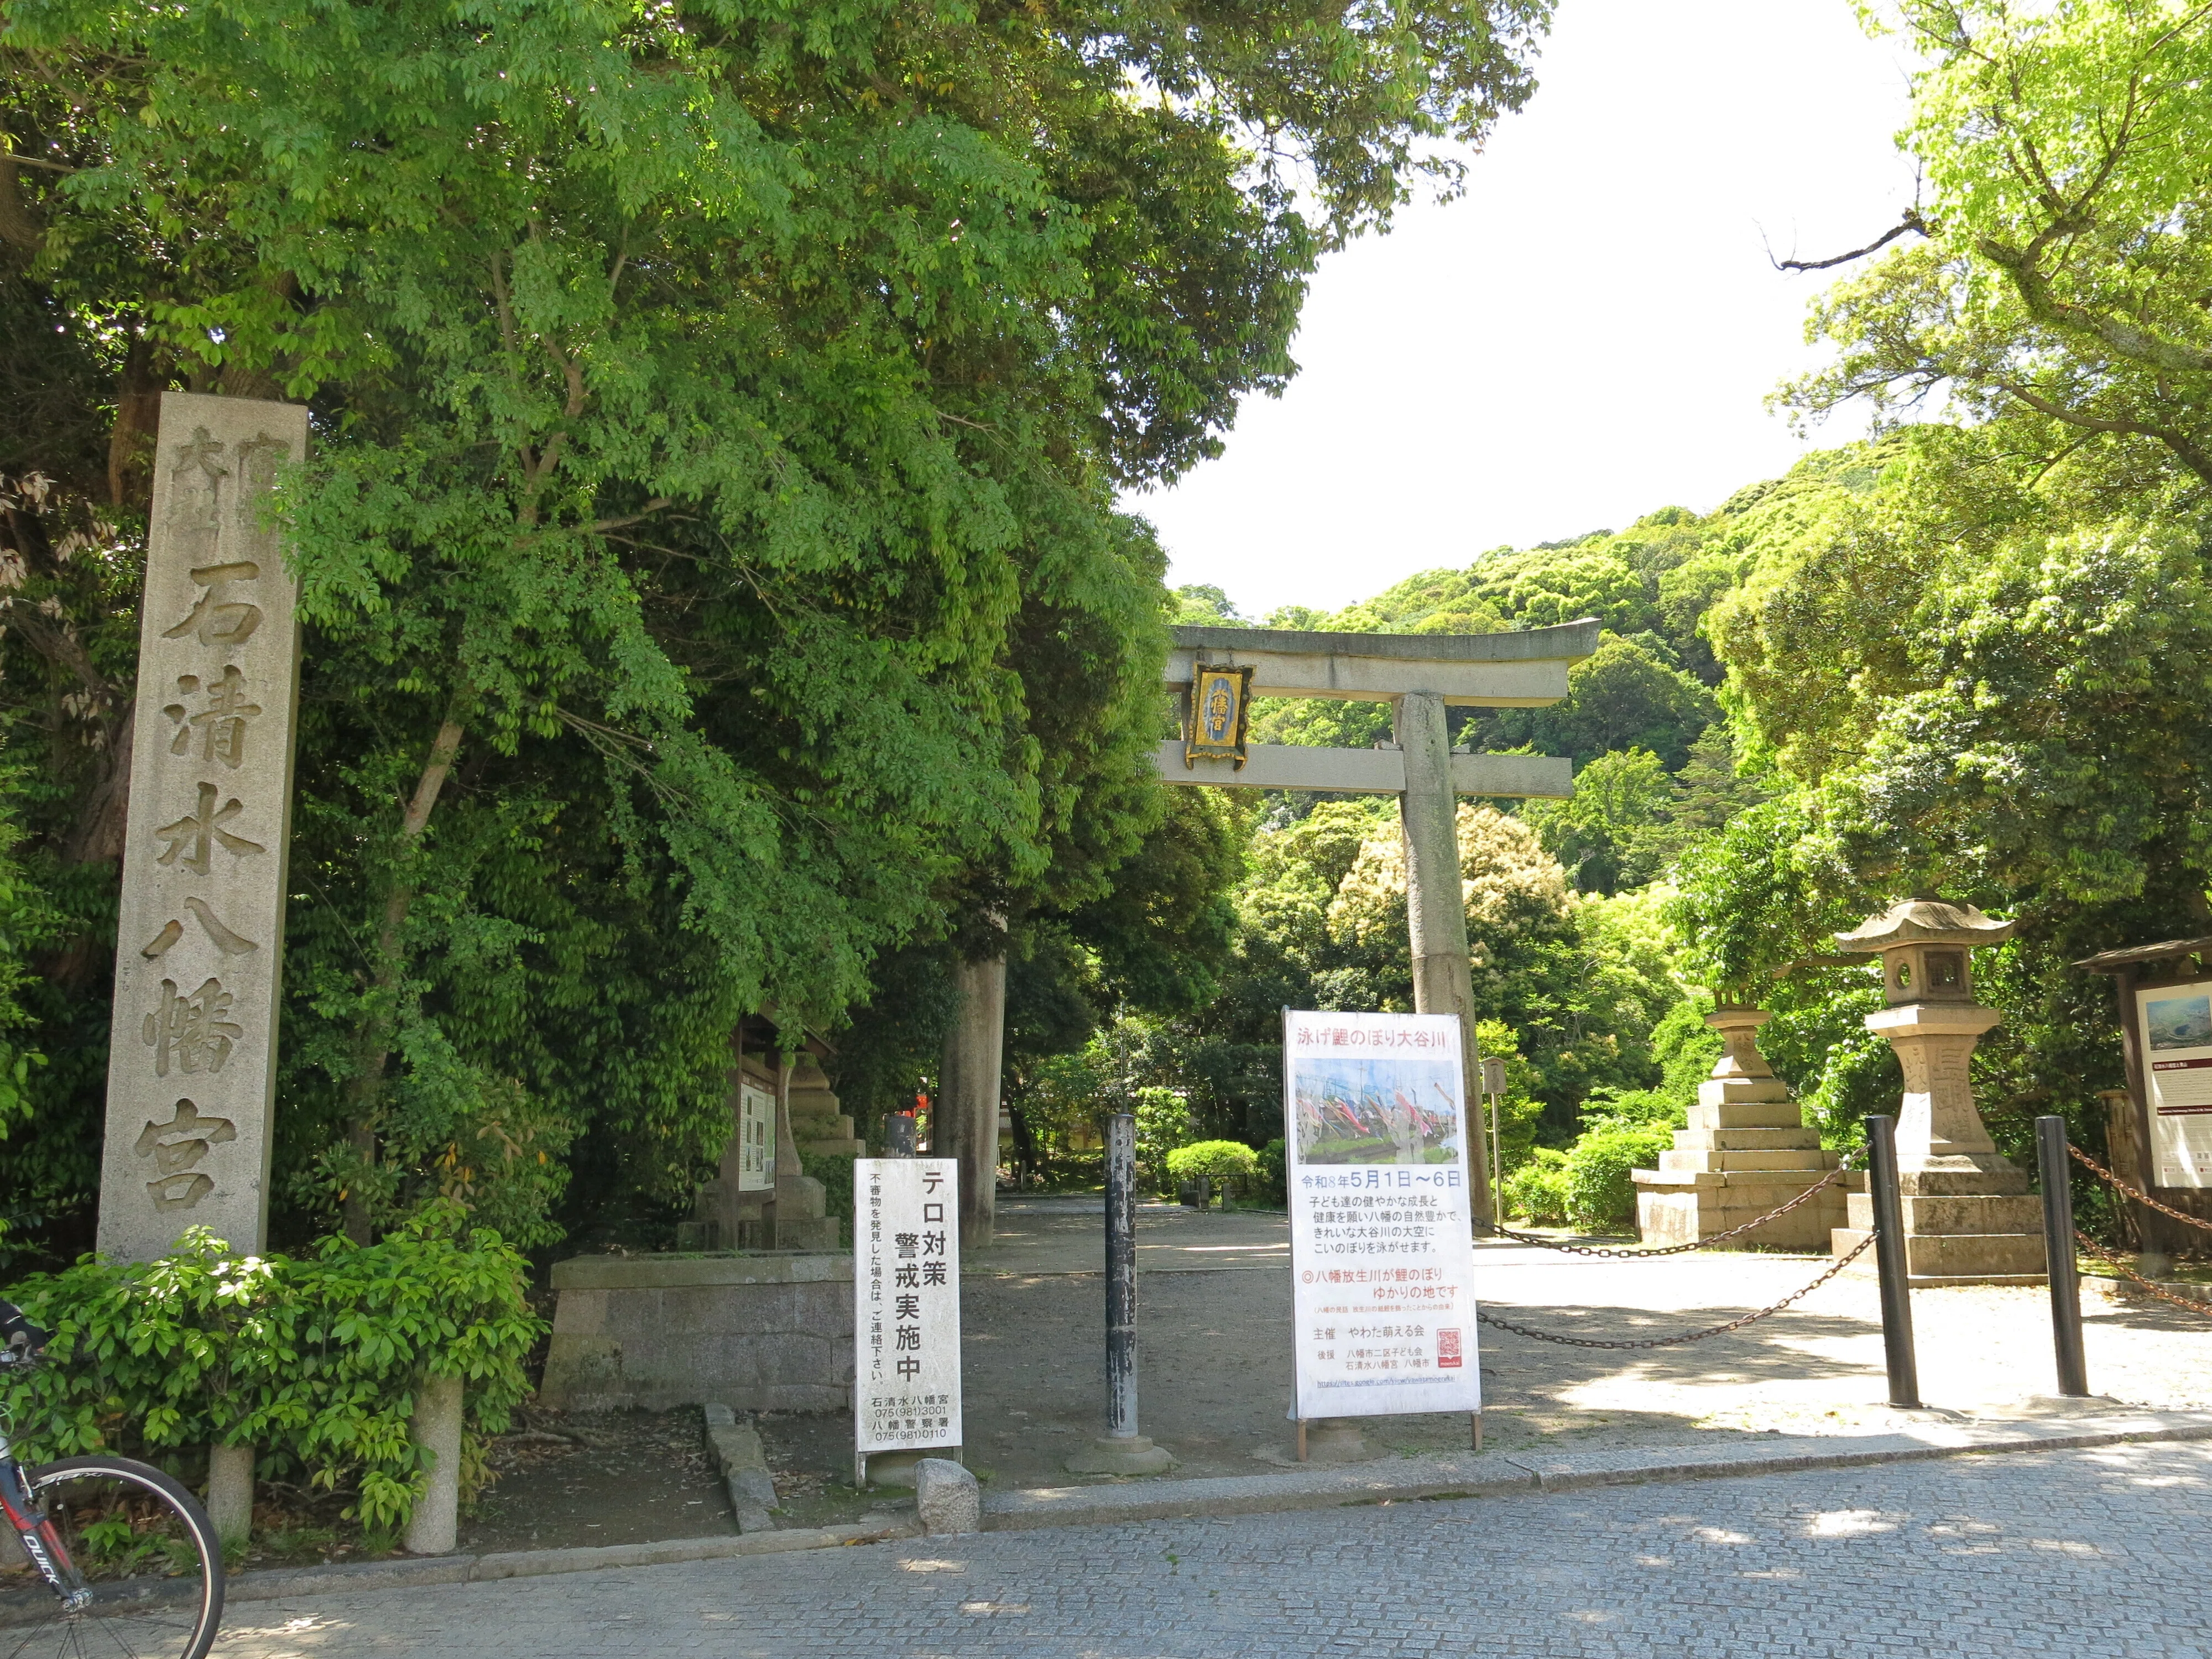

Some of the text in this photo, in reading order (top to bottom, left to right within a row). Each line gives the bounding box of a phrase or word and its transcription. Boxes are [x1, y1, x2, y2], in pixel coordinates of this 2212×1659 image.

[135, 560, 267, 1214] 石清水八幡宮
[1297, 1027, 1446, 1048] 泳げ鯉のぼり大谷川
[1309, 1195, 1438, 1208] 子ども達の健やかな成長と
[1313, 1210, 1462, 1223] 健康を願い八幡の自然豊かで、
[922, 1171, 947, 1286] テロ対策
[1313, 1226, 1435, 1239] きれいな大谷川の大空に
[1314, 1241, 1436, 1254] こいのぼりを泳がせます。
[870, 1173, 883, 1385] 不審物を発見した場合は、ご連絡下さい。
[1373, 1284, 1458, 1300] ゆかりの地です
[895, 1233, 920, 1383] 警戒実施中
[1313, 1324, 1425, 1340] 主催 やわた萌える会
[1317, 1347, 1423, 1360] 後援 八幡市二区子ども会
[1345, 1358, 1430, 1371] 石清水八幡宮 八幡市
[872, 1395, 948, 1407] 石清水八幡宮
[875, 1406, 946, 1418] 075(981)3001
[872, 1417, 949, 1431] 八幡警察署
[875, 1428, 947, 1441] 075(981)0110
[23, 1535, 60, 1584] QUICK
